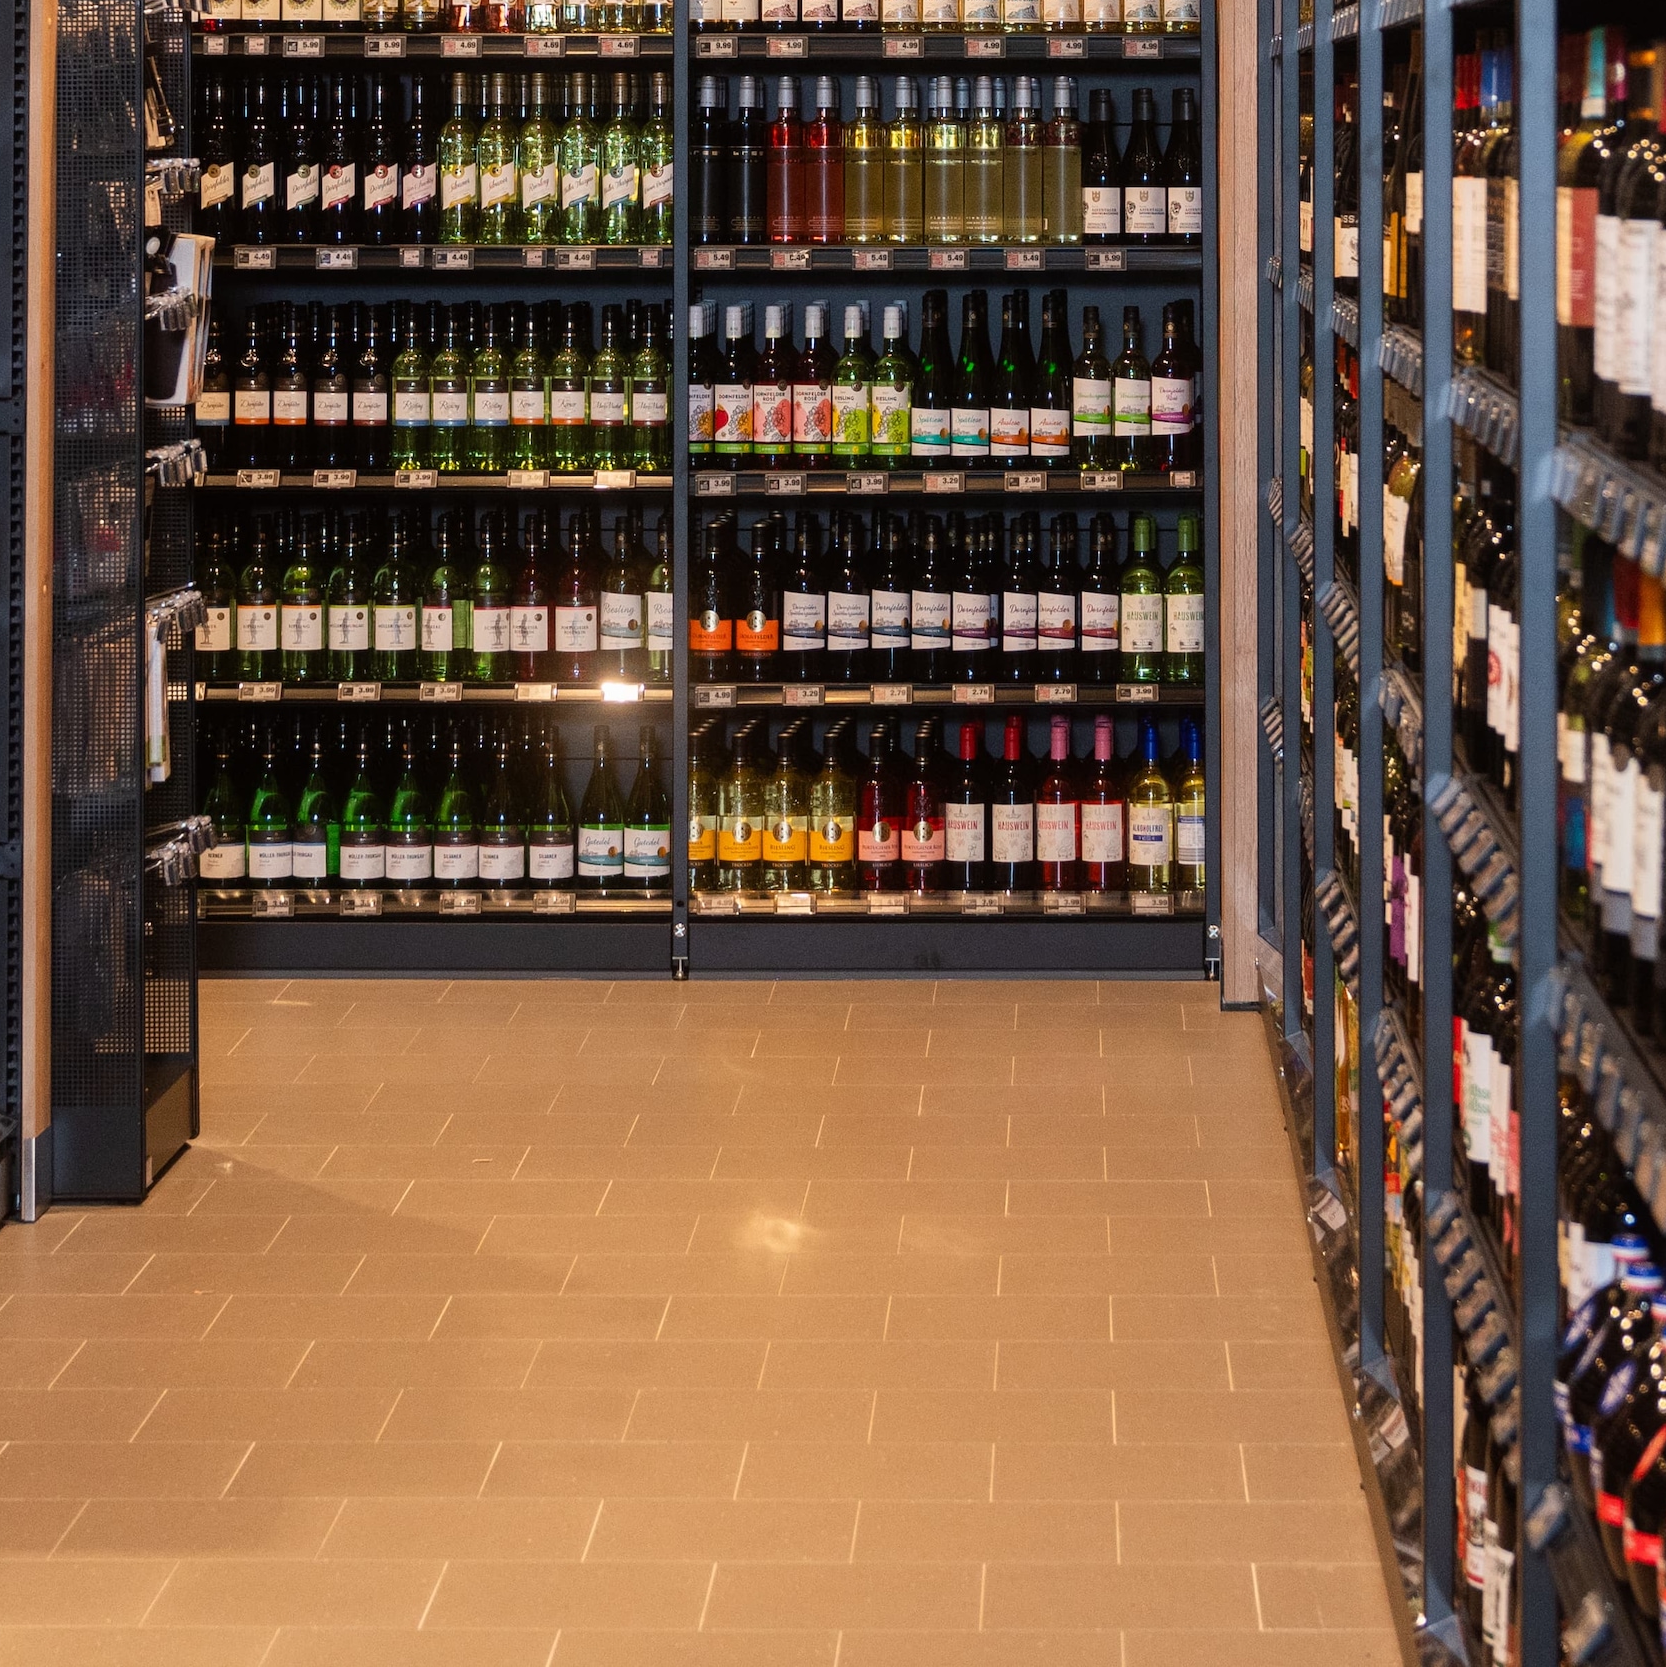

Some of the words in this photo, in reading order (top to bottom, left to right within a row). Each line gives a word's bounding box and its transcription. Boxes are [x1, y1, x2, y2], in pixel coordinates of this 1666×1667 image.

[303, 41, 318, 49] 5.99
[384, 41, 400, 49] 5.99
[603, 603, 635, 615] Riesling
[654, 603, 673, 614] Ries
[875, 601, 908, 612] Dornfelder
[915, 602, 948, 613] Dornfelder
[1127, 612, 1159, 621] HAUSWEIN
[947, 820, 978, 830] HAUSWEIN
[998, 821, 1030, 831] HAUSWEIN
[1038, 820, 1069, 830] HAUSWEIN
[1085, 821, 1117, 830] HAUSWEIN
[1133, 824, 1163, 833] ALKOHOLFREI
[584, 836, 610, 847] Gutedel
[633, 837, 660, 848] Gutedel
